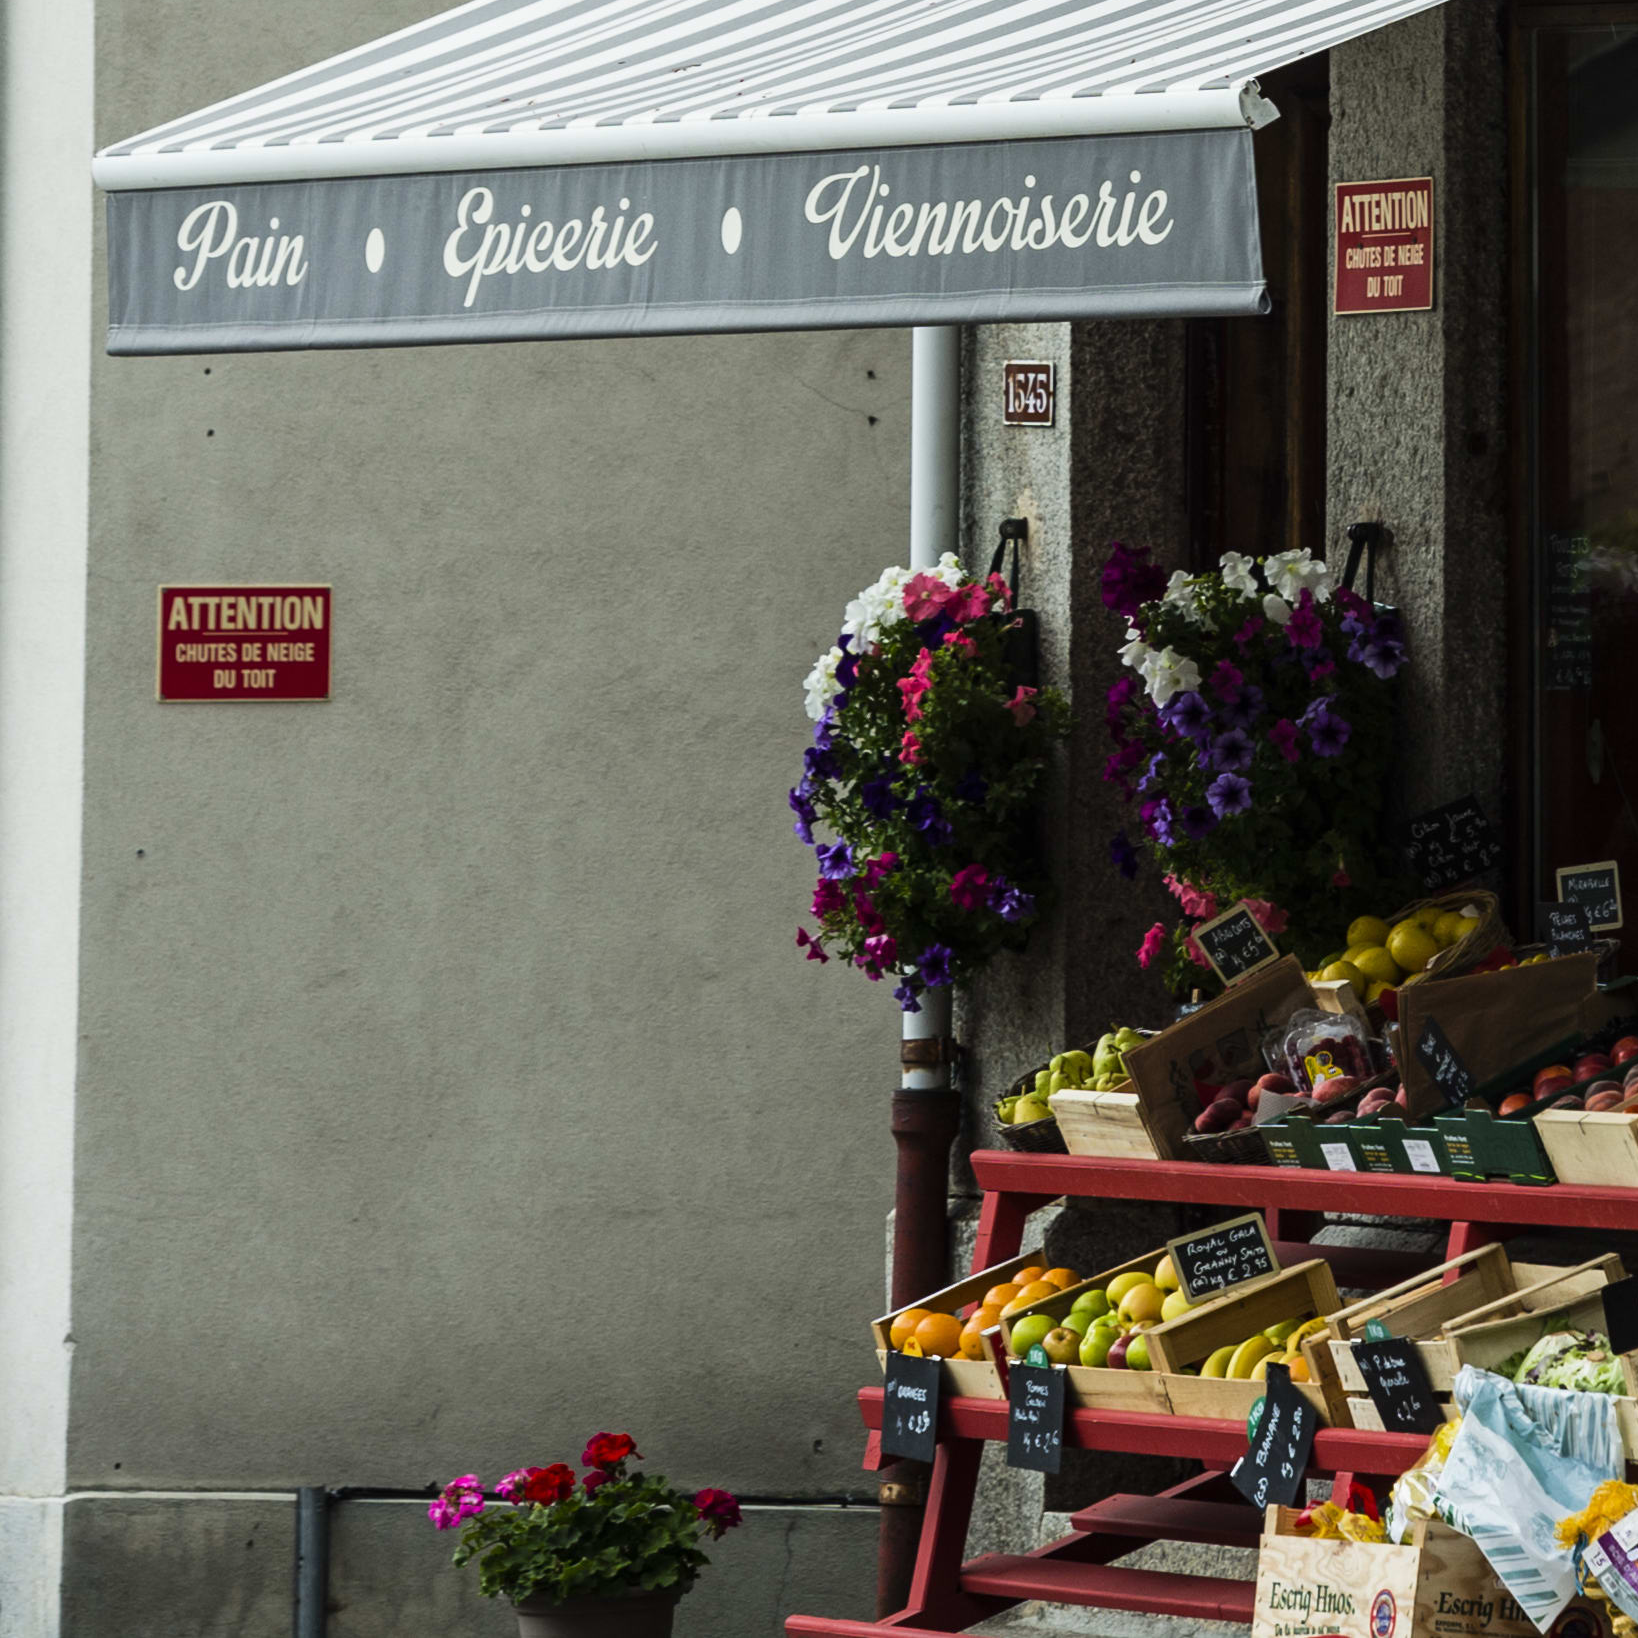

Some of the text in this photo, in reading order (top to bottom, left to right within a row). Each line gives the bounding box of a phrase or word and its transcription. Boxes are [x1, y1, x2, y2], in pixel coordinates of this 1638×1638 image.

[1341, 190, 1428, 233] ATTENTION
[173, 163, 1173, 308] Pain Epicerie Viennoiserie
[1346, 244, 1424, 269] CHUTES DE NEIGE
[1367, 275, 1403, 298] DU TOIT
[1008, 373, 1047, 413] 1545
[168, 596, 324, 630] ATTENTION
[176, 643, 315, 662] CHUTES DE NEIGE
[213, 669, 276, 688] DU TOIT
[1187, 1226, 1256, 1256] ROYAL GALA
[1194, 1255, 1237, 1275] GRANNY
[1228, 1268, 1238, 1281] €
[1256, 1402, 1281, 1467] BANANE
[1269, 1582, 1356, 1624] Escrig Hnos.
[1437, 1591, 1494, 1628] Escrig
